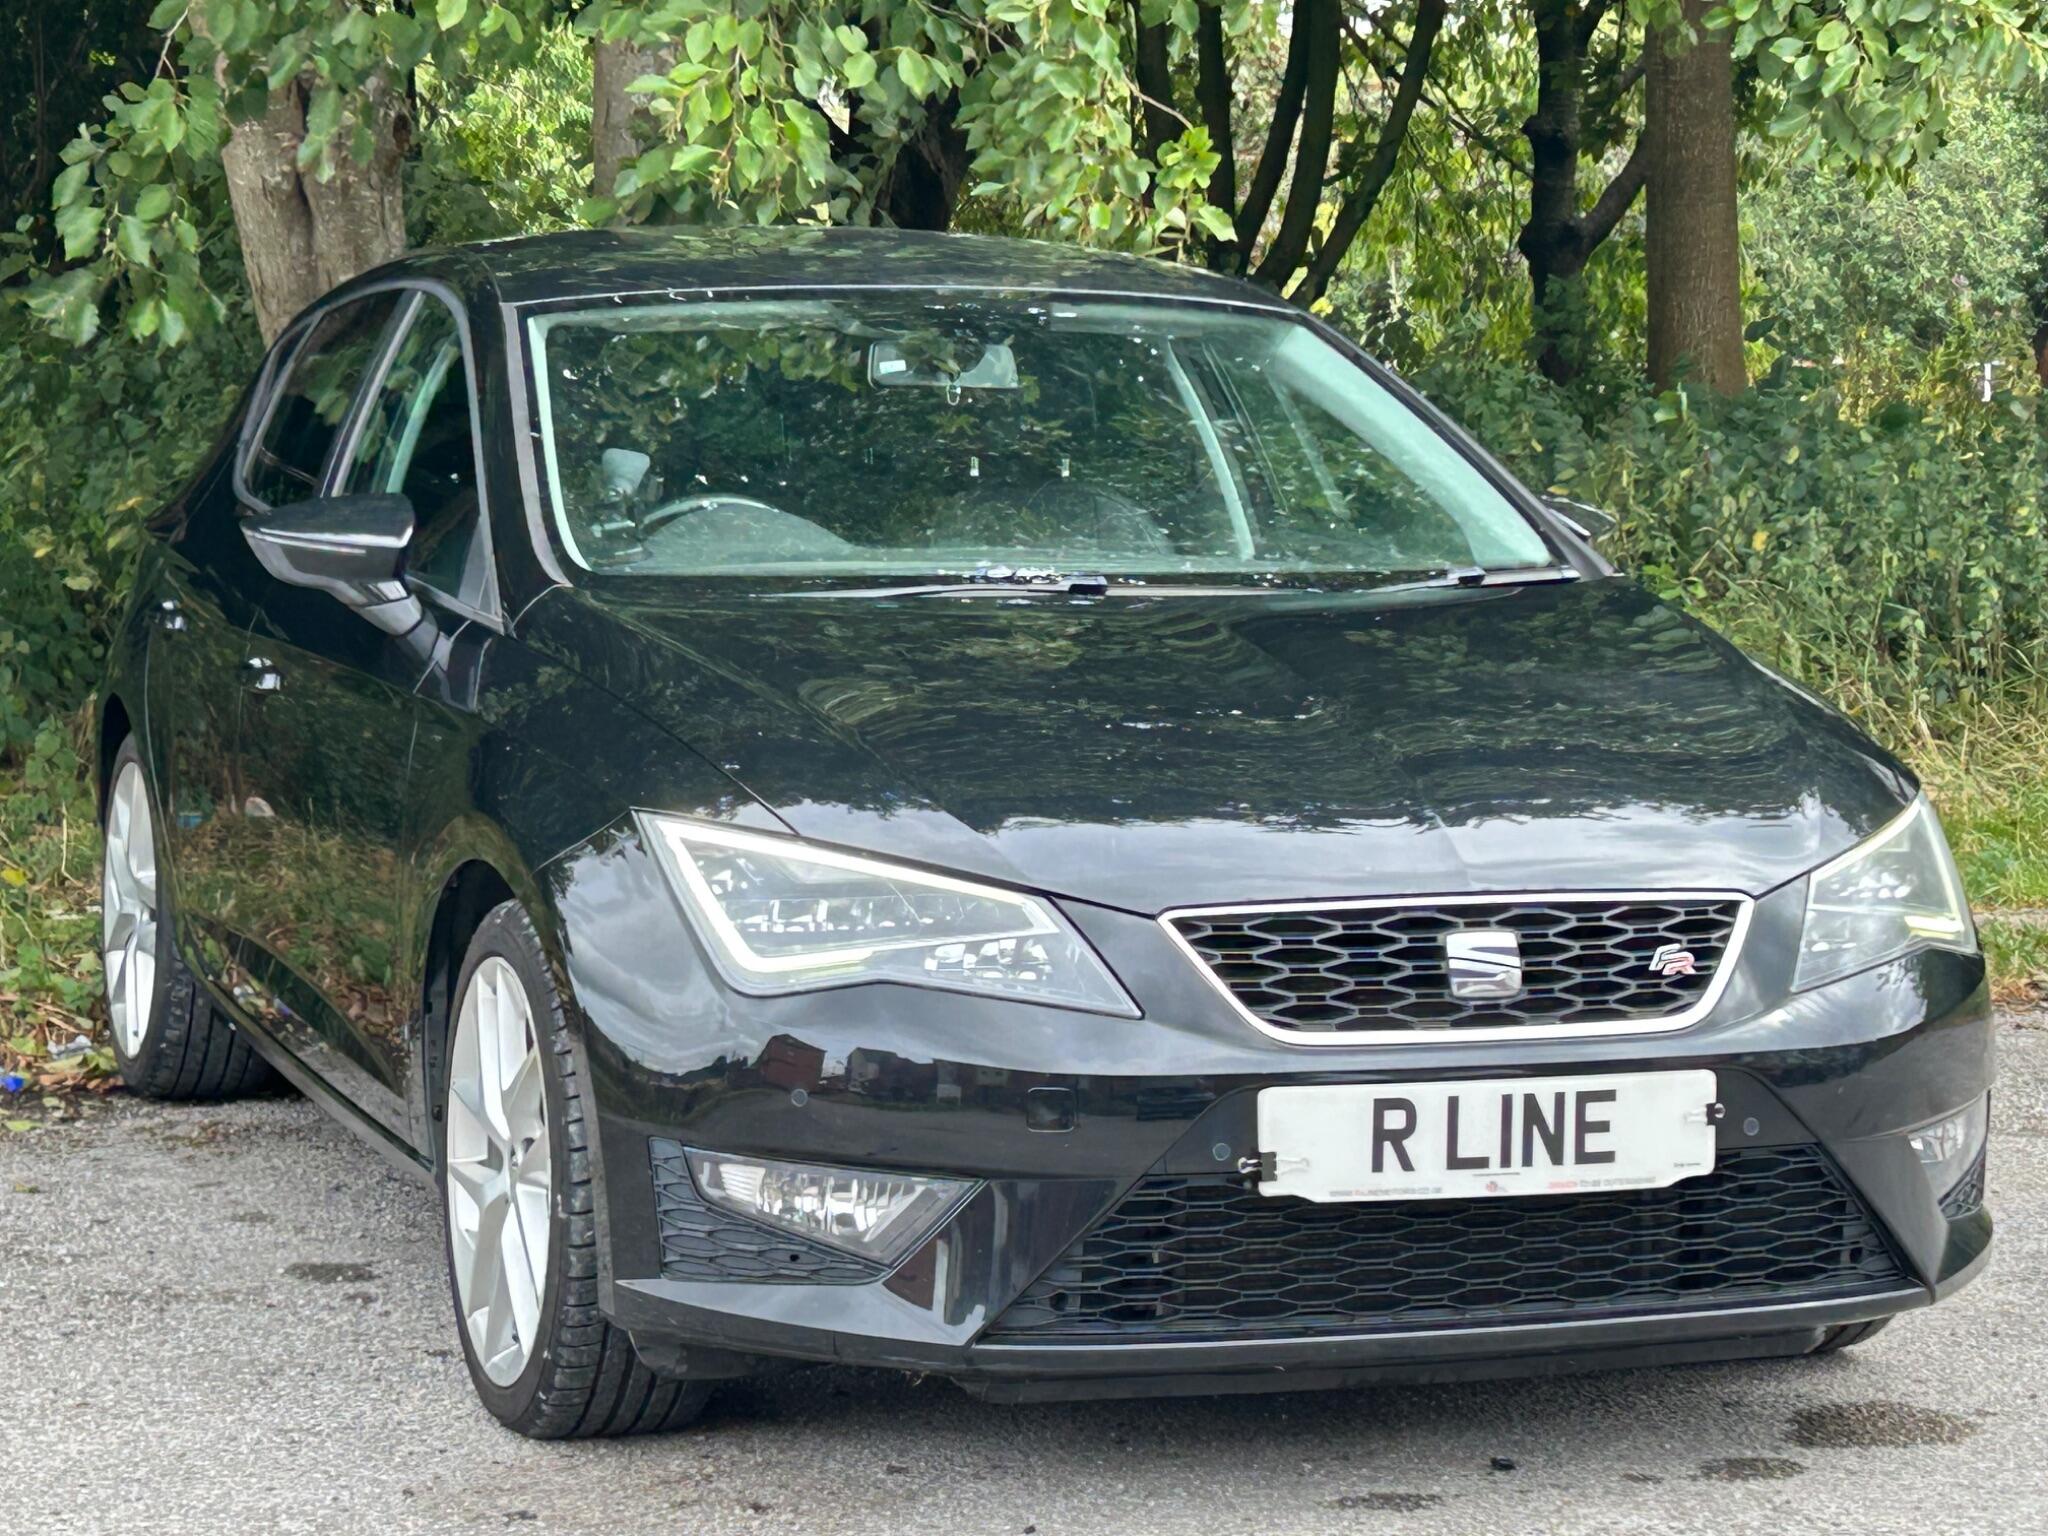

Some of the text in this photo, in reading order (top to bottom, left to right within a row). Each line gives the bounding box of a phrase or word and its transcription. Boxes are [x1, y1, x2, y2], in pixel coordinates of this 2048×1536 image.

[1648, 943, 1696, 975] FR
[1371, 1089, 1617, 1173] R LINE
